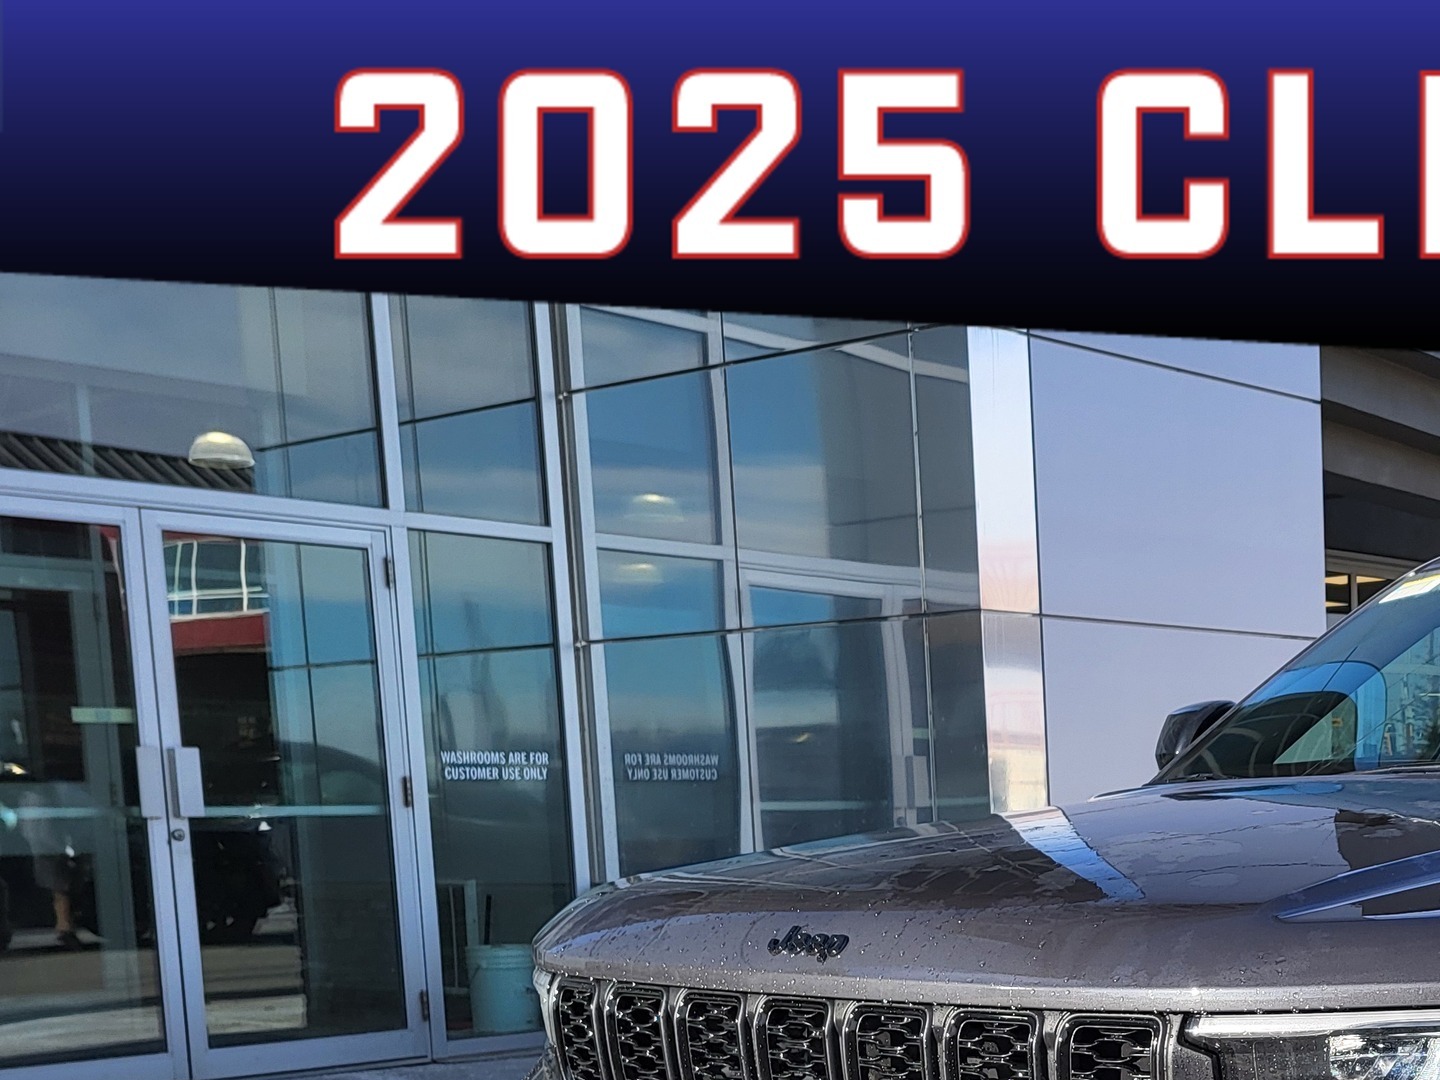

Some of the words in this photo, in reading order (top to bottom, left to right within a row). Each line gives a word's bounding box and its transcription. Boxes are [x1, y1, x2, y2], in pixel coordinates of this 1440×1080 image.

[441, 750, 506, 765] WASHROOMS
[508, 752, 528, 765] ARE
[530, 752, 549, 765] FOR
[445, 766, 500, 780] CUSTOMER
[502, 766, 522, 780] USE
[524, 766, 548, 780] ONLY
[767, 926, 849, 963] Jeep
